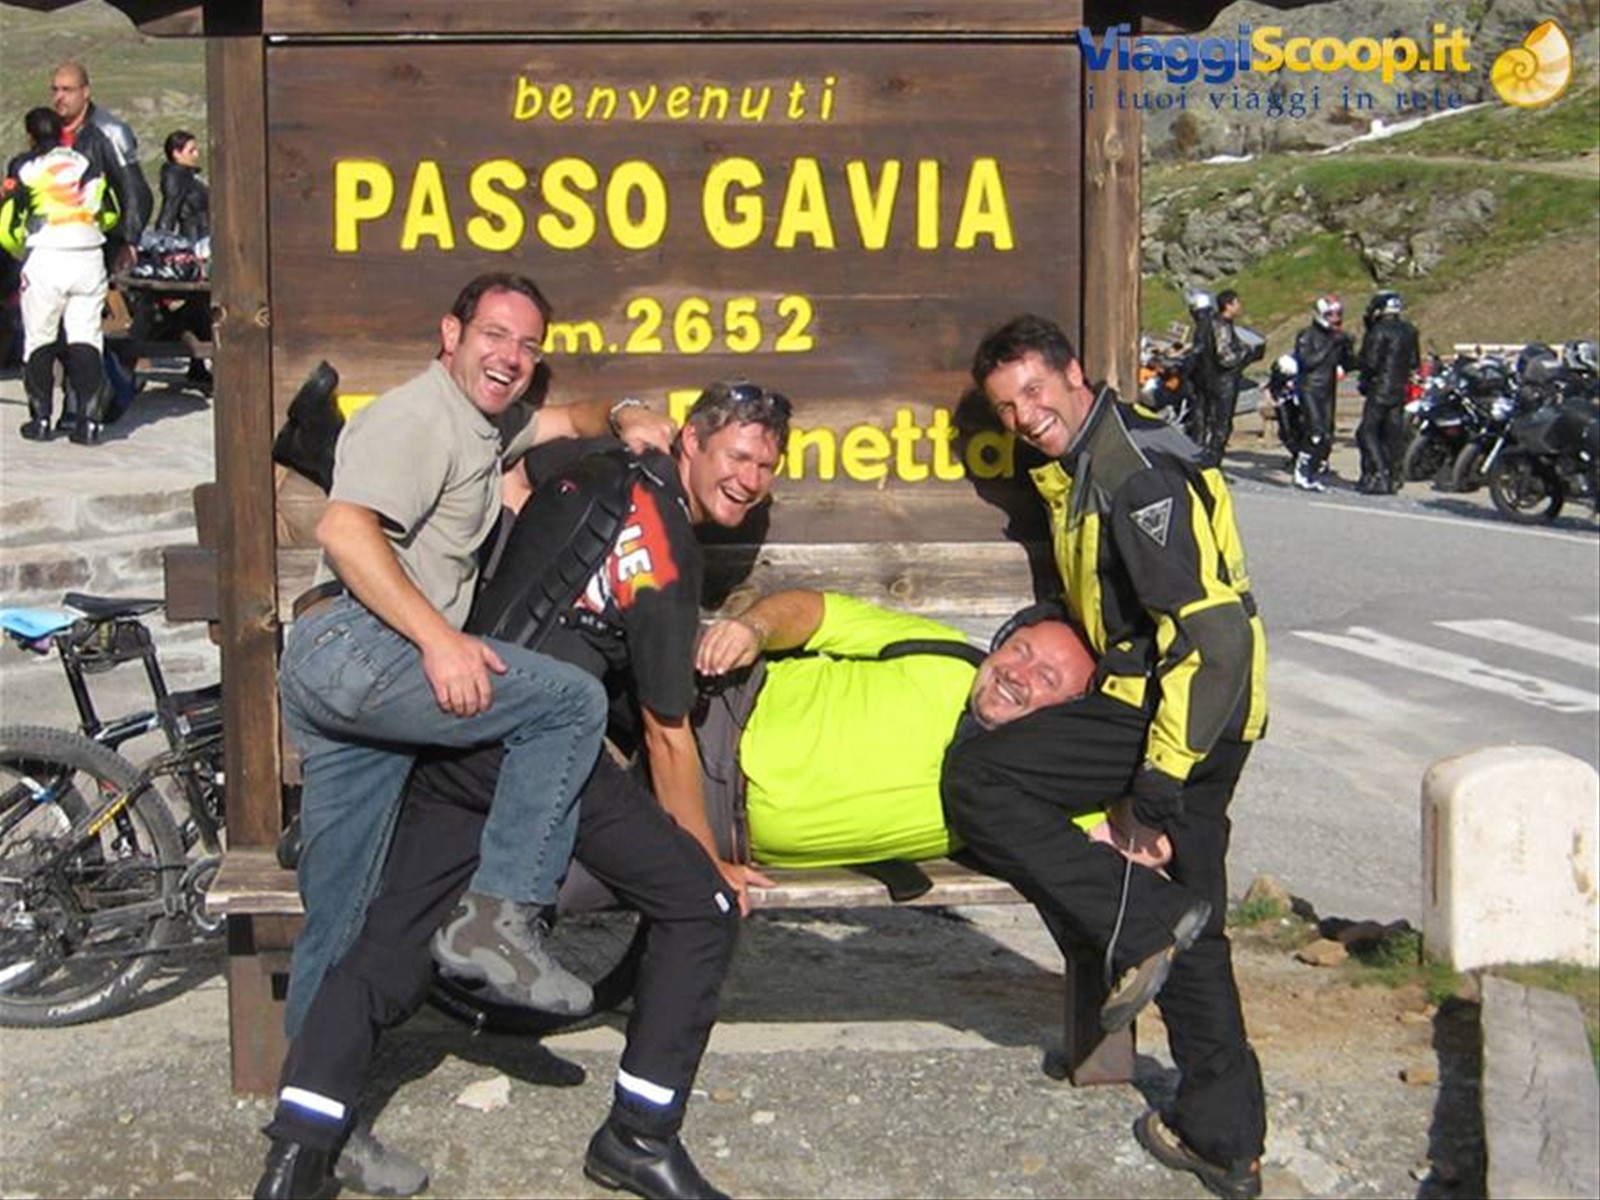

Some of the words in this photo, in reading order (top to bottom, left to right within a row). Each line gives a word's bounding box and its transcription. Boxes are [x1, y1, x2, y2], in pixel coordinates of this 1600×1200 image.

[512, 75, 838, 124] benvenuti
[334, 157, 668, 254] PASSO
[701, 155, 1015, 252] GAVIA
